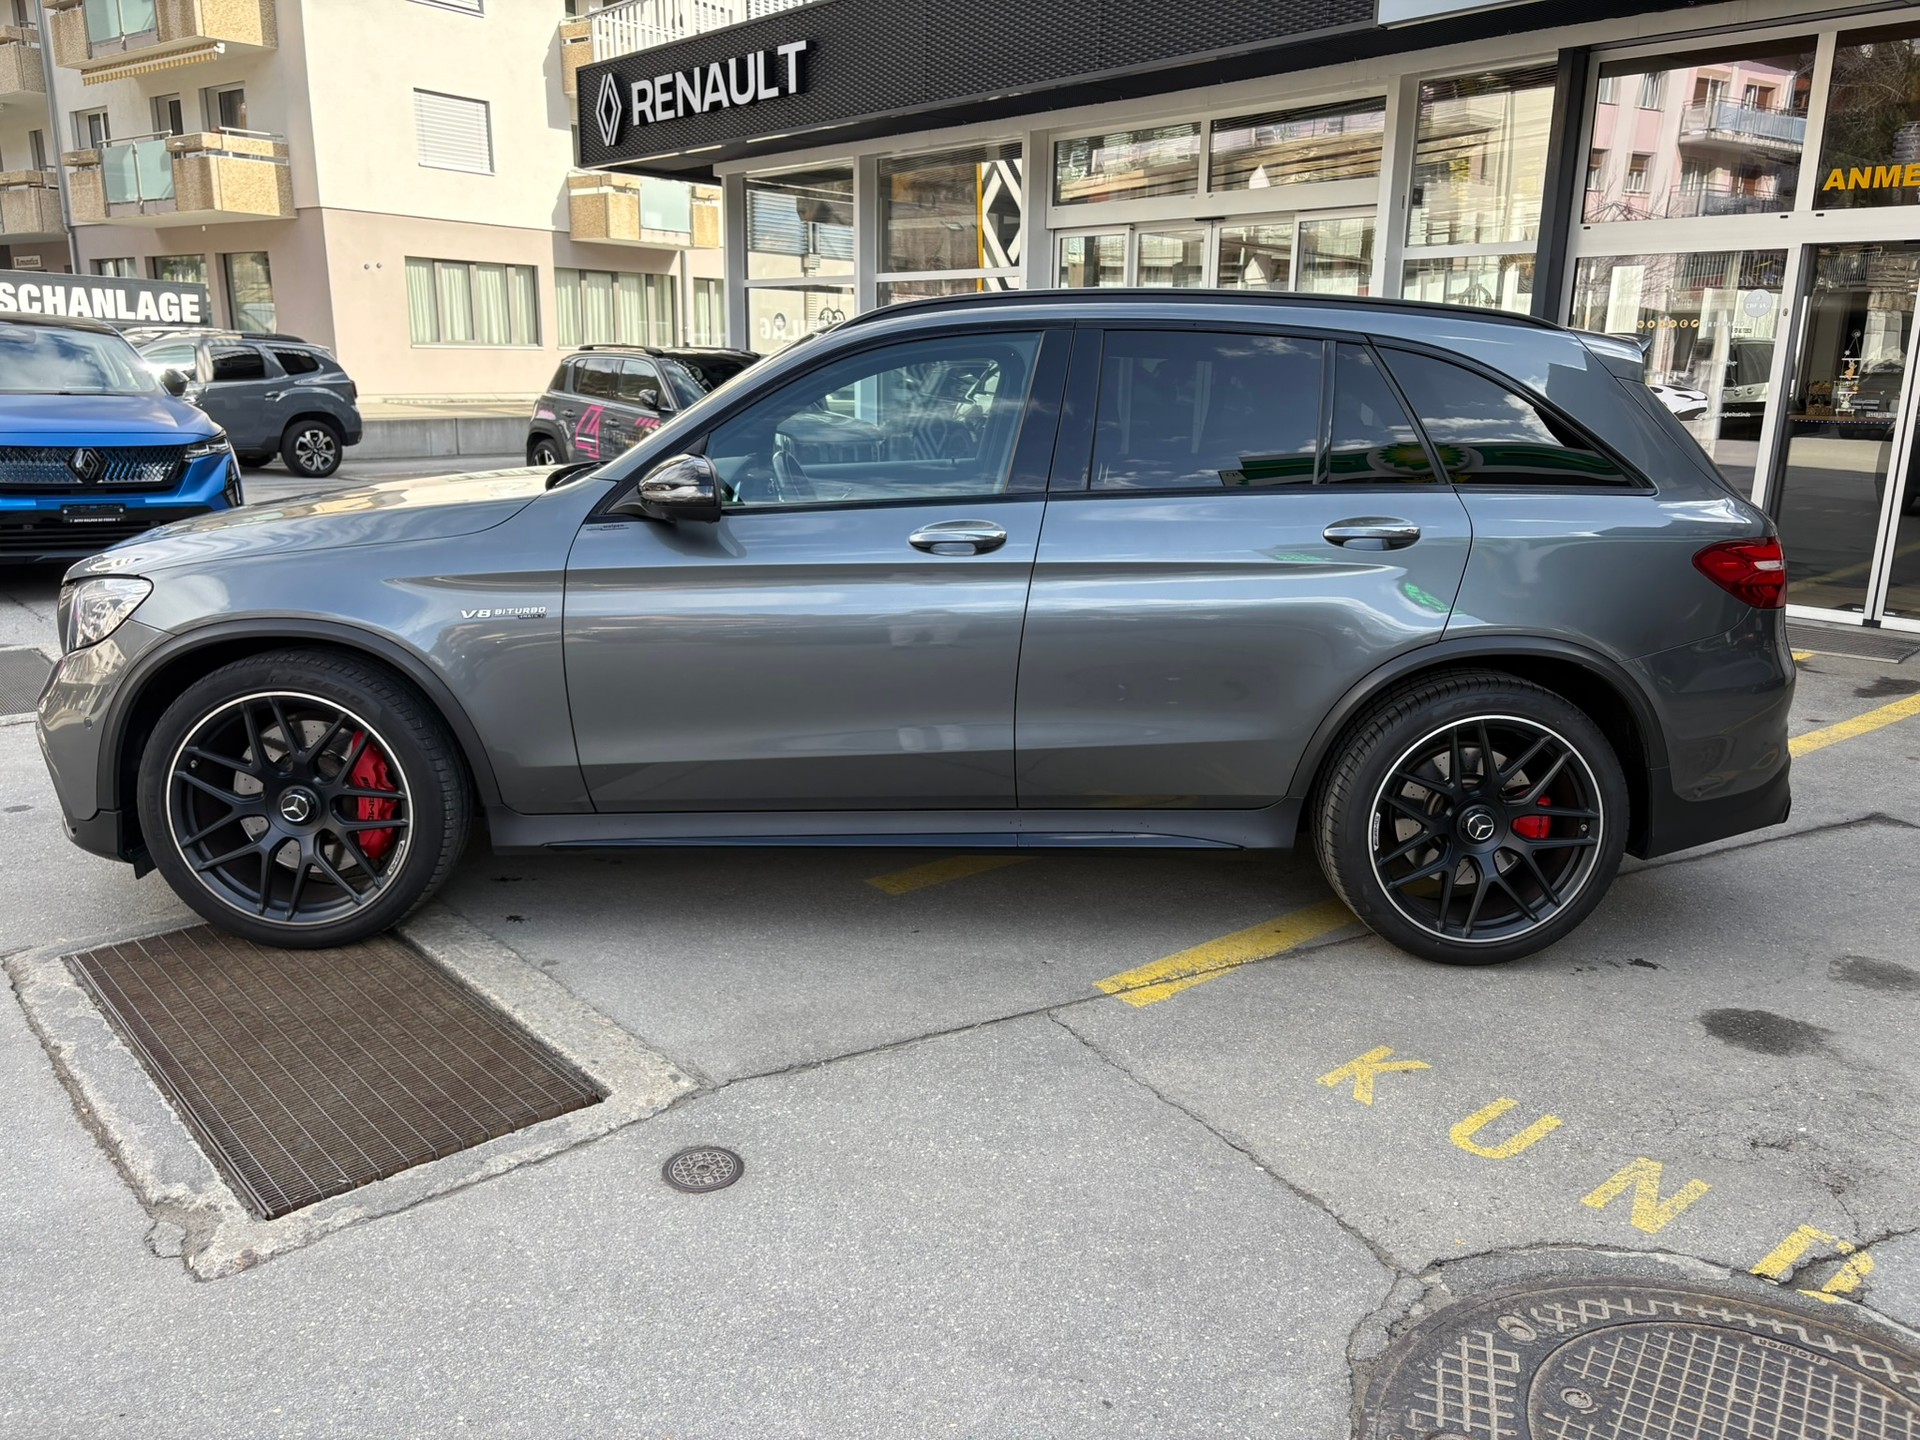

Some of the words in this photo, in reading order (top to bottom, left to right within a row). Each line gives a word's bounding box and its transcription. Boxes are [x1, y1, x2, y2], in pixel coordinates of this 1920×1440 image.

[630, 40, 807, 126] RENAULT
[1822, 162, 1920, 191] ANME
[0, 282, 201, 323] SCHANLAGE
[460, 609, 491, 619] V8
[494, 606, 546, 615] BITURBO
